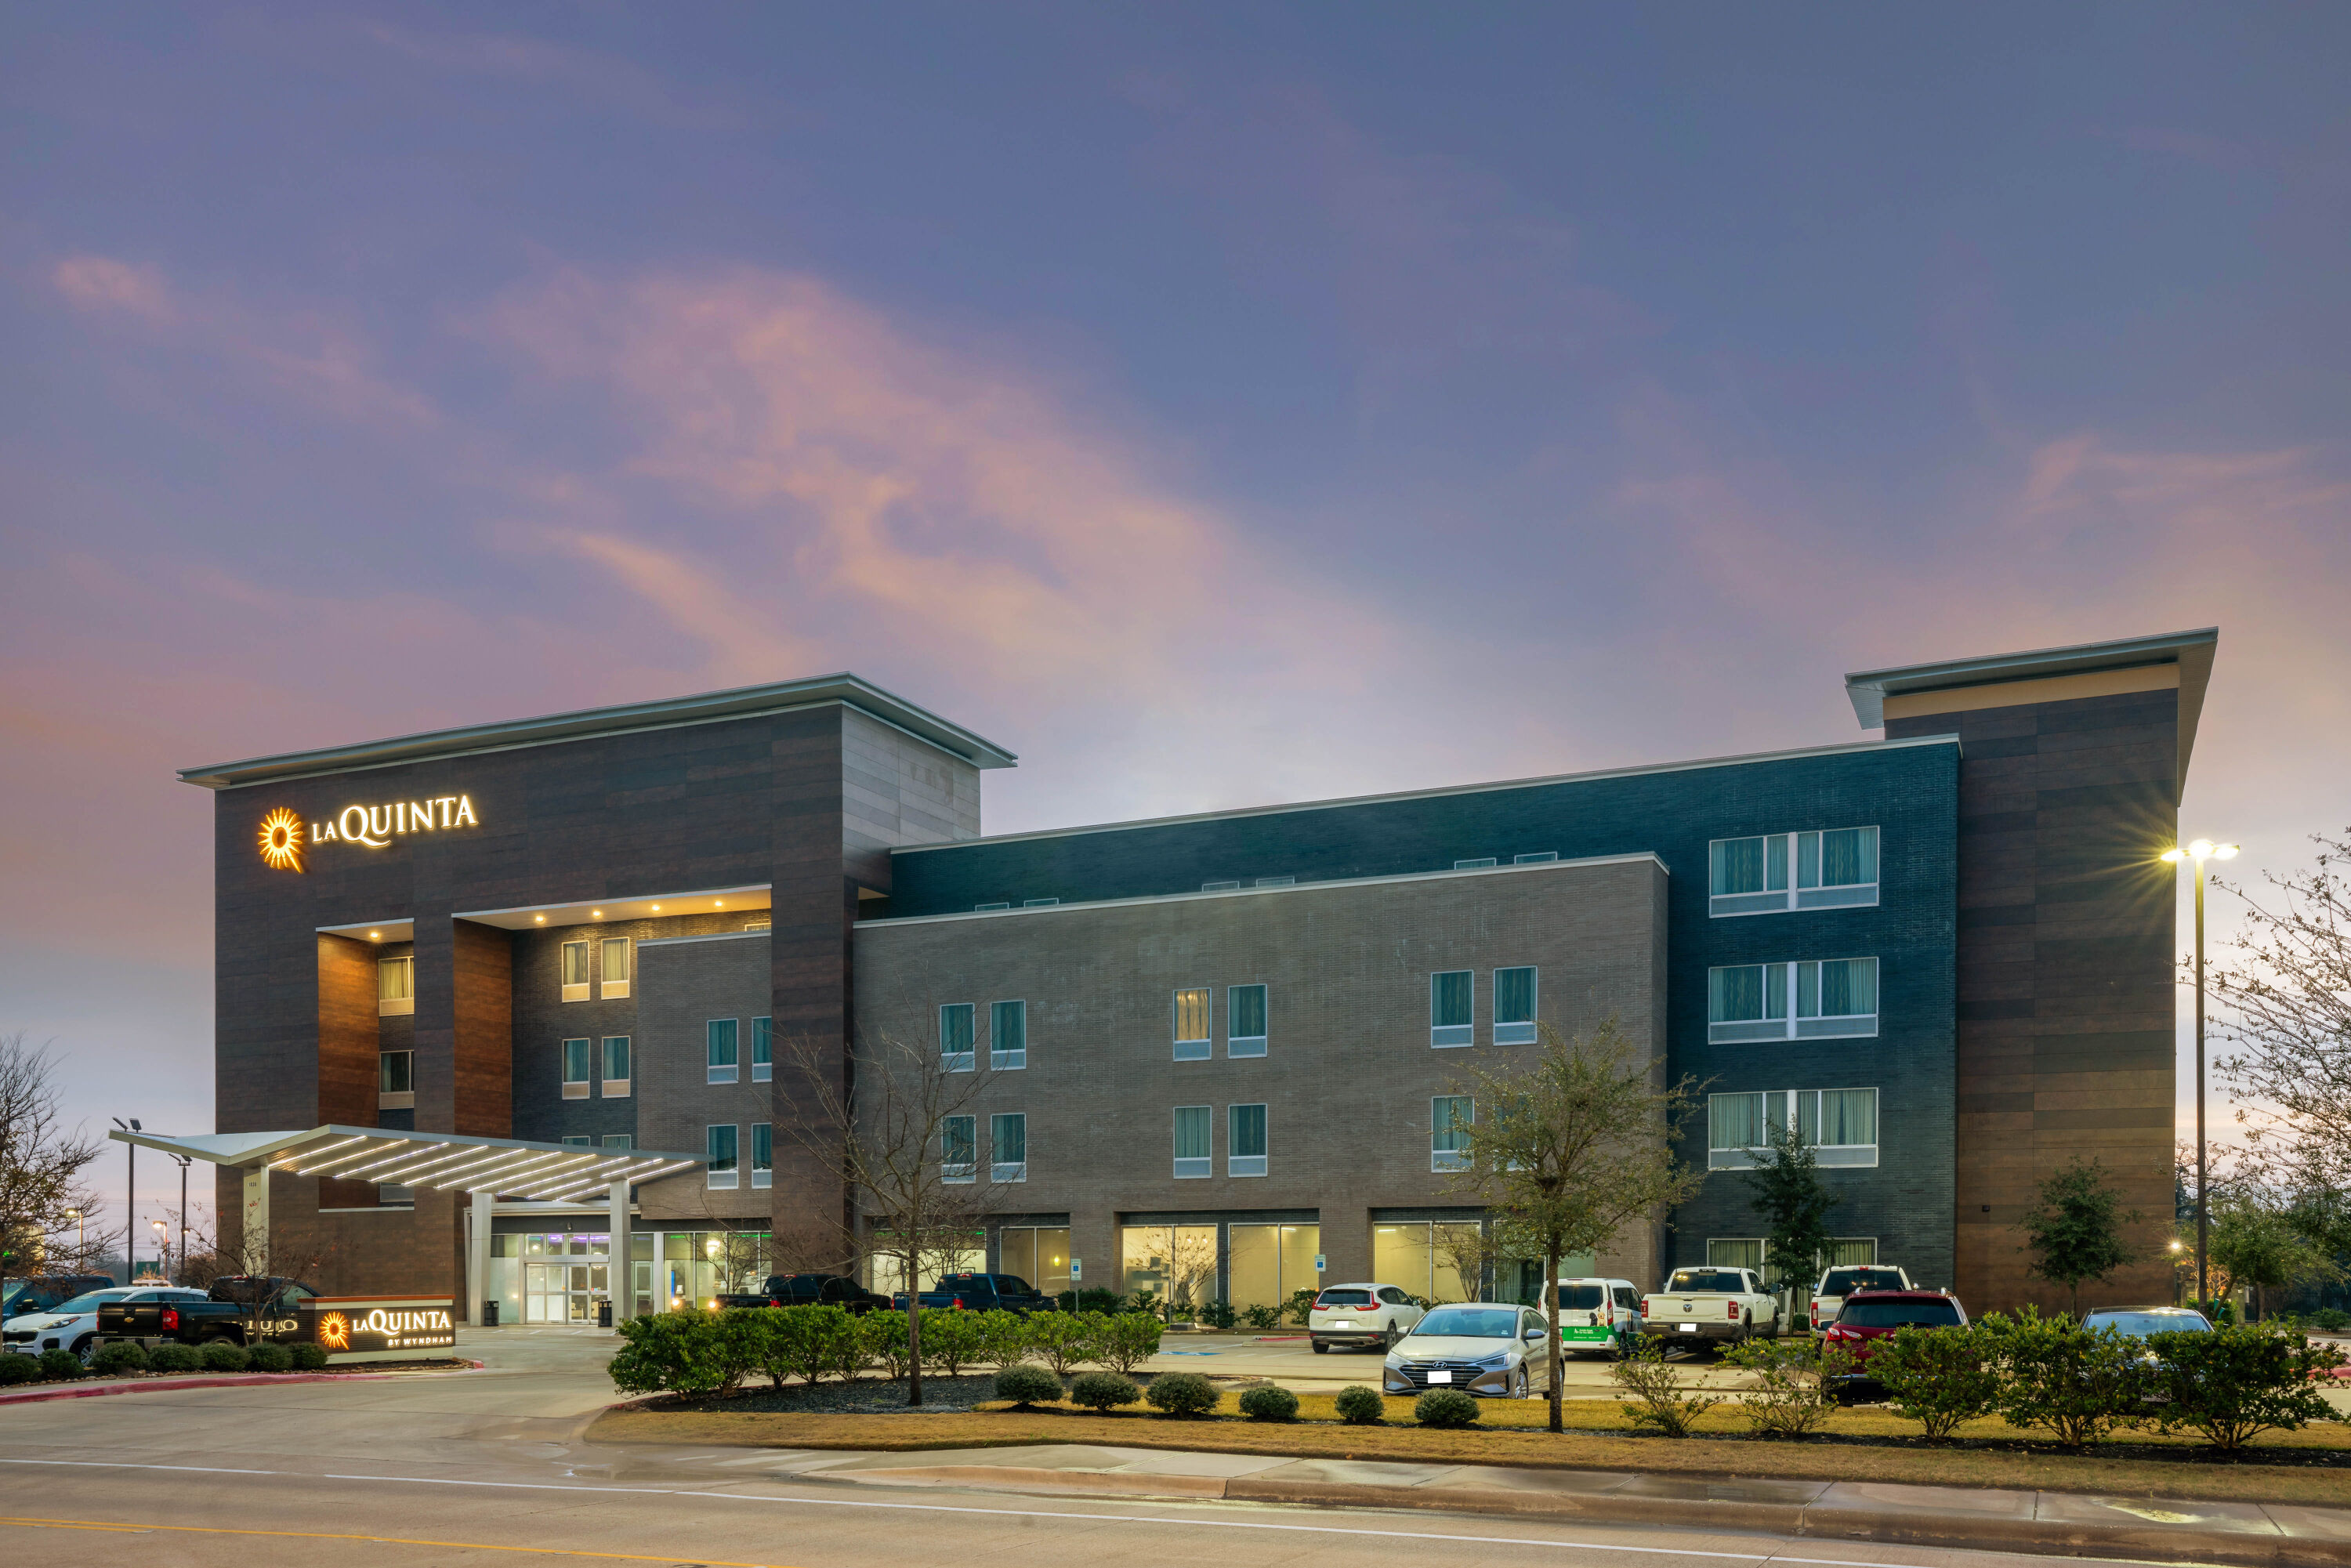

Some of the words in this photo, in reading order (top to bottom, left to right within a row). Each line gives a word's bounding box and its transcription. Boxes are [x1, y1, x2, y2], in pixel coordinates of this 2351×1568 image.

[313, 821, 339, 843] LA
[339, 794, 479, 847] QUINTA
[353, 1319, 369, 1332] LA
[368, 1309, 452, 1336] QUINTA
[388, 1338, 400, 1347] BY
[403, 1336, 453, 1346] WYNDHAM
